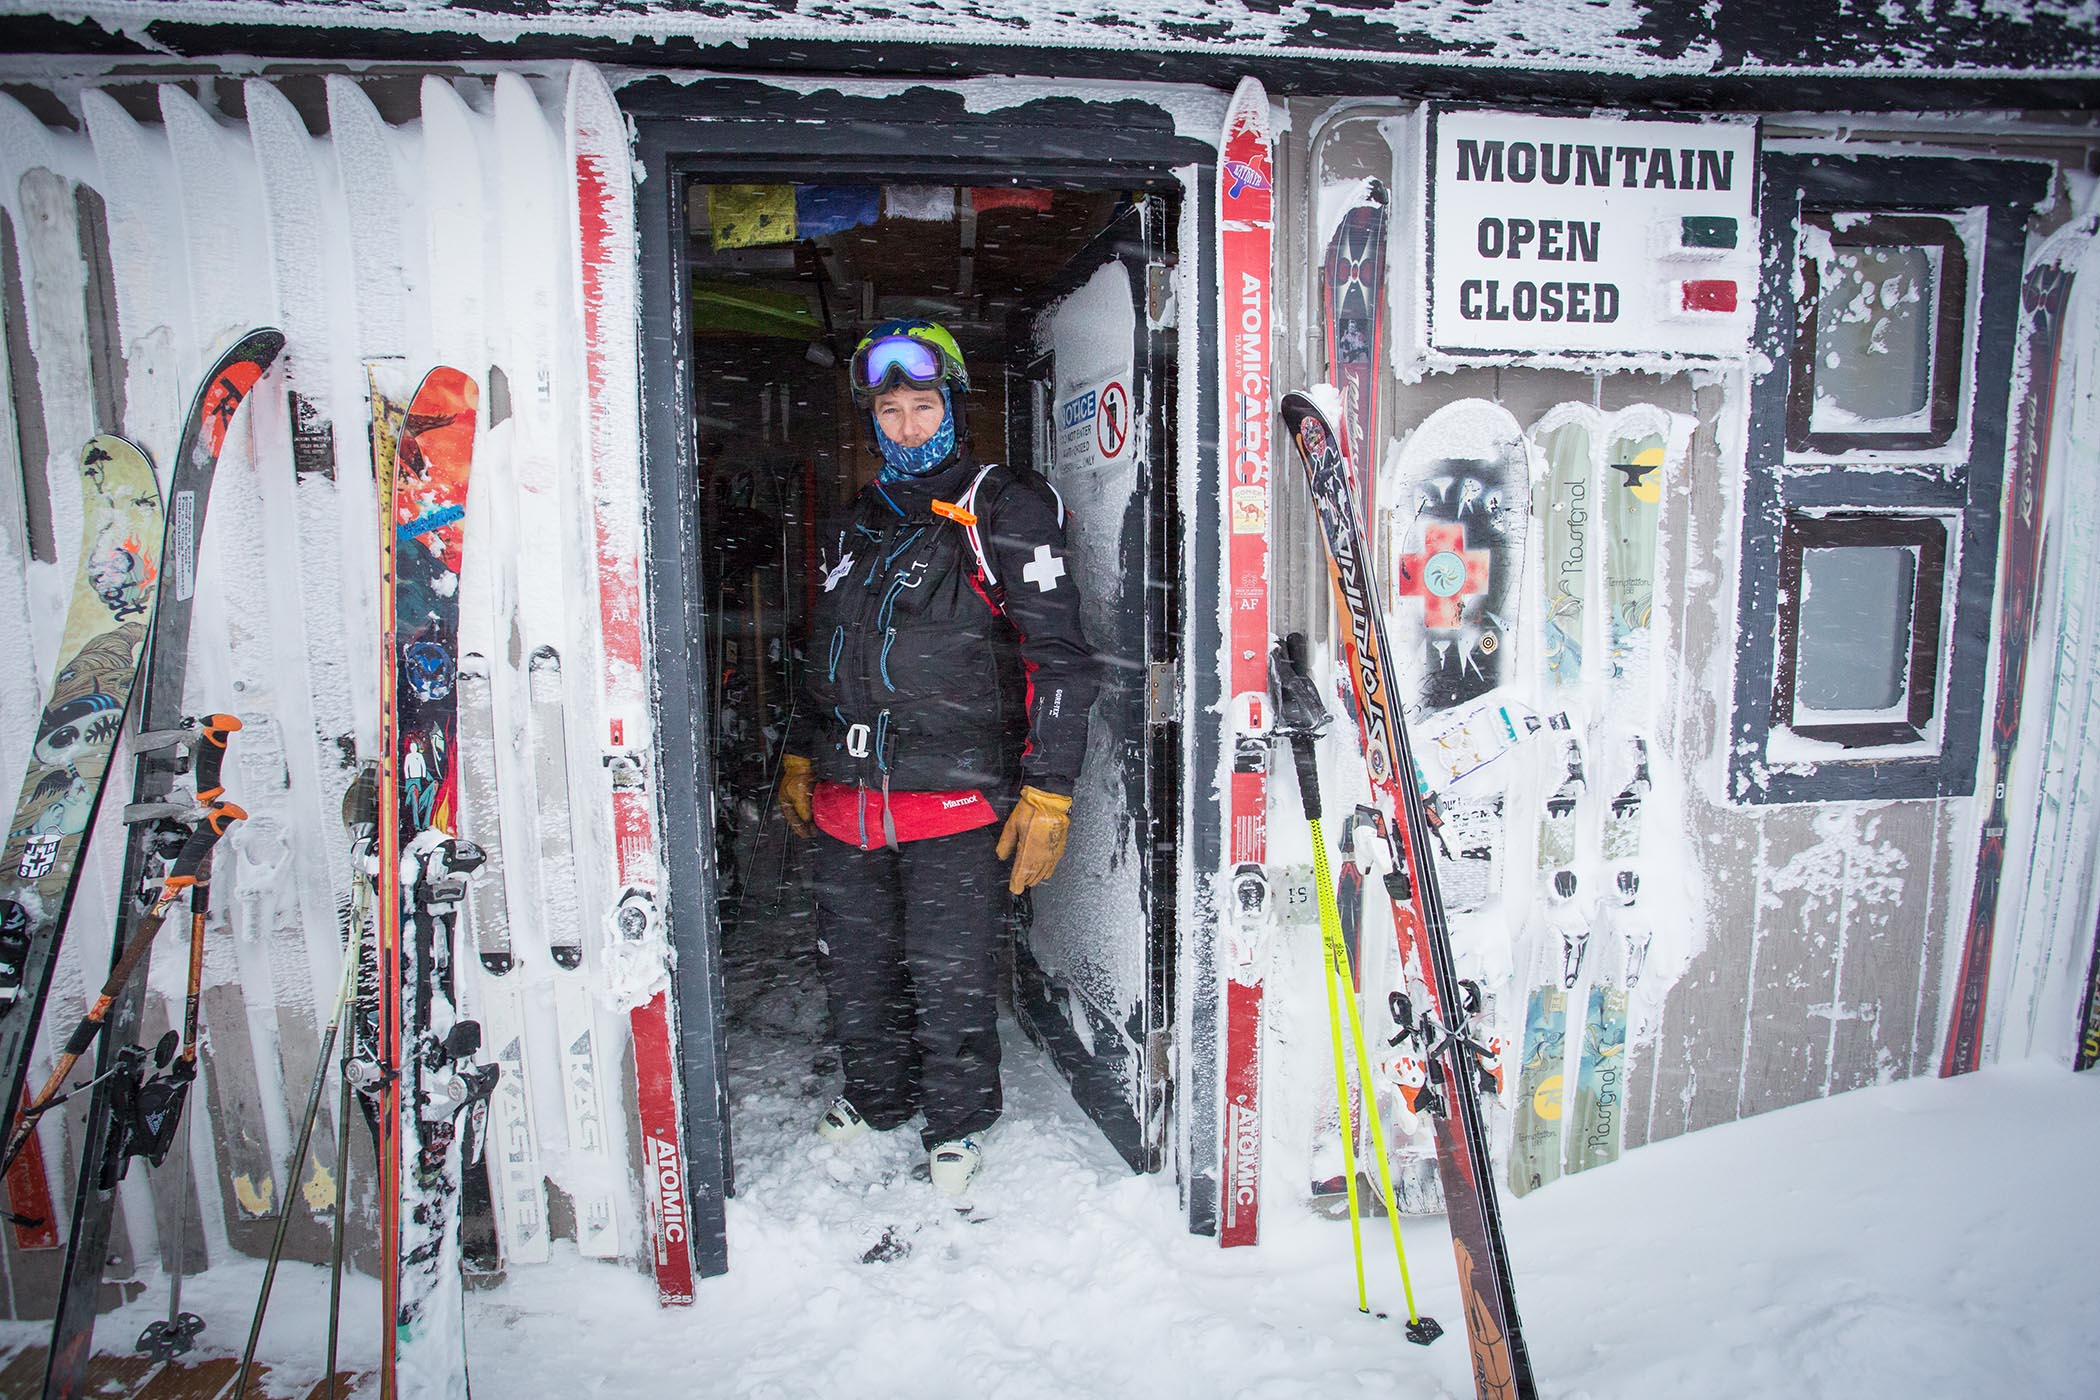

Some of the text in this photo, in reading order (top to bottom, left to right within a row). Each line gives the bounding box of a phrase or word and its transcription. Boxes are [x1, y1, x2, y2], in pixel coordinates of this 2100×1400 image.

[1456, 139, 1734, 191] MOUNTAIN
[1478, 217, 1600, 262] OPEN
[1460, 279, 1620, 323] CLOSED
[1241, 272, 1262, 396] ATOMIC
[1063, 393, 1095, 427] OTICE
[1235, 391, 1262, 484] ARC
[1561, 477, 1588, 575] Rossignol
[1240, 598, 1259, 610] AF
[943, 795, 978, 810] Marmot
[1588, 1065, 1617, 1150] Rossignol
[1237, 1105, 1259, 1206] ATOMIC
[657, 1139, 685, 1244] ATOMIC
[660, 1295, 693, 1304] 225
